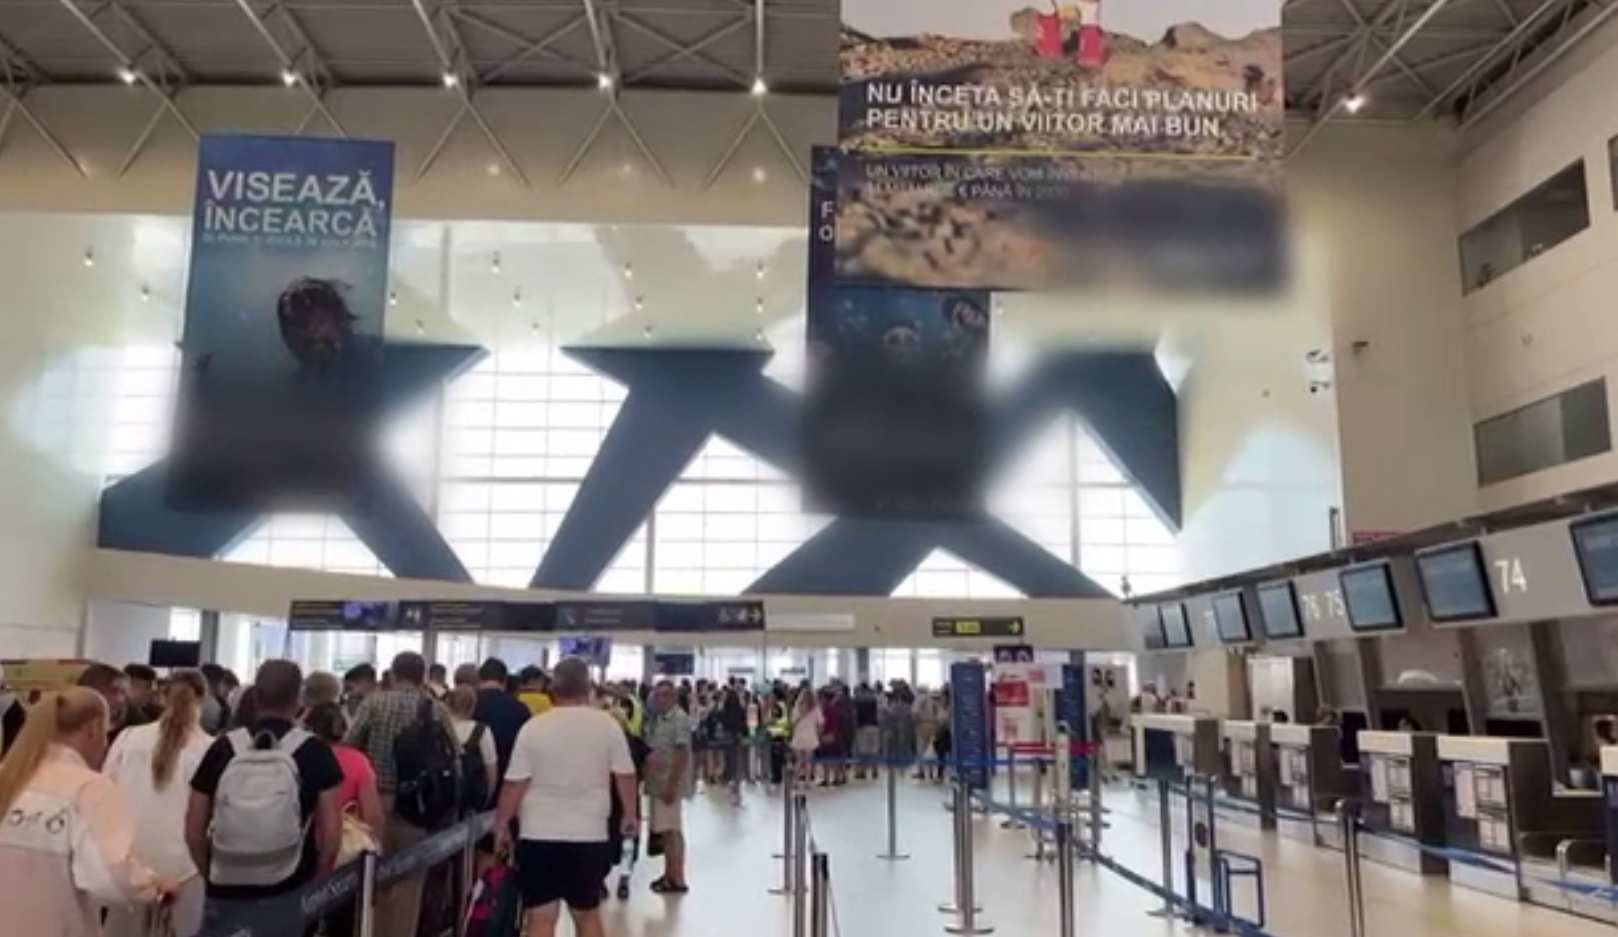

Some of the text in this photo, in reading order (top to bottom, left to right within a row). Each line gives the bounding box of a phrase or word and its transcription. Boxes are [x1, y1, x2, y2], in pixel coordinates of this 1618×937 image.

[867, 83, 902, 103] NU
[909, 79, 1001, 106] ÎNCETA
[1081, 86, 1137, 109] FACI
[1143, 89, 1257, 112] PLANURI
[866, 107, 969, 132] PENTRU
[976, 110, 1013, 132] UN
[1020, 111, 1103, 133] VIITOR
[1111, 114, 1158, 136] MAI
[207, 168, 386, 210] VISEAZĂ,
[203, 198, 378, 237] ÎNCEARCĂ
[1493, 557, 1528, 594] 74
